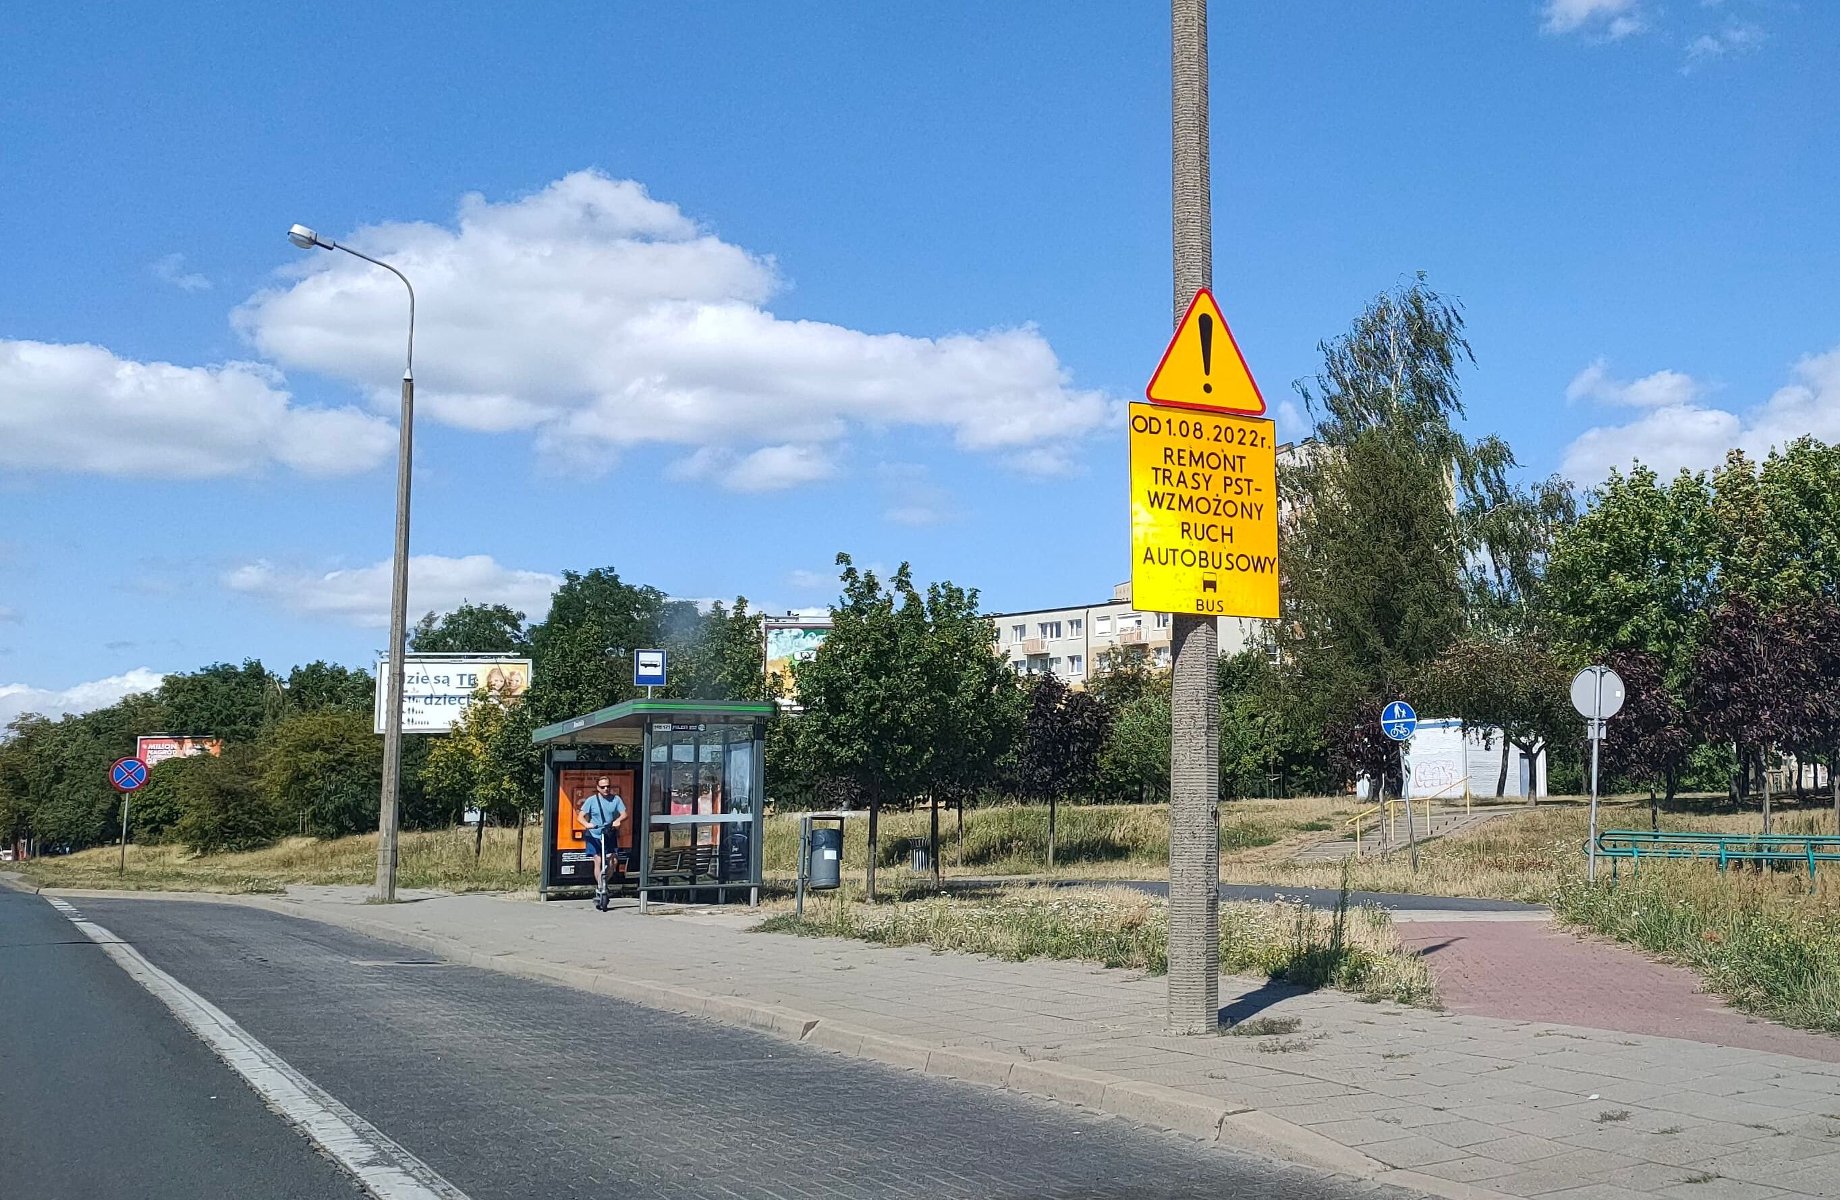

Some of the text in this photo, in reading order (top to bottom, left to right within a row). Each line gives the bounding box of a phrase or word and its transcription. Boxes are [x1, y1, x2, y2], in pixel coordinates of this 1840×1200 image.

[1163, 447, 1246, 473] REMONT
[1152, 467, 1263, 496] TRASY PST-
[1147, 490, 1264, 521] WZMOŻONY
[1181, 521, 1233, 543] RUCH
[1143, 546, 1277, 574] AUTOBUSOWY
[1196, 598, 1224, 612] BUS
[433, 675, 450, 687] są
[456, 673, 478, 687] TE
